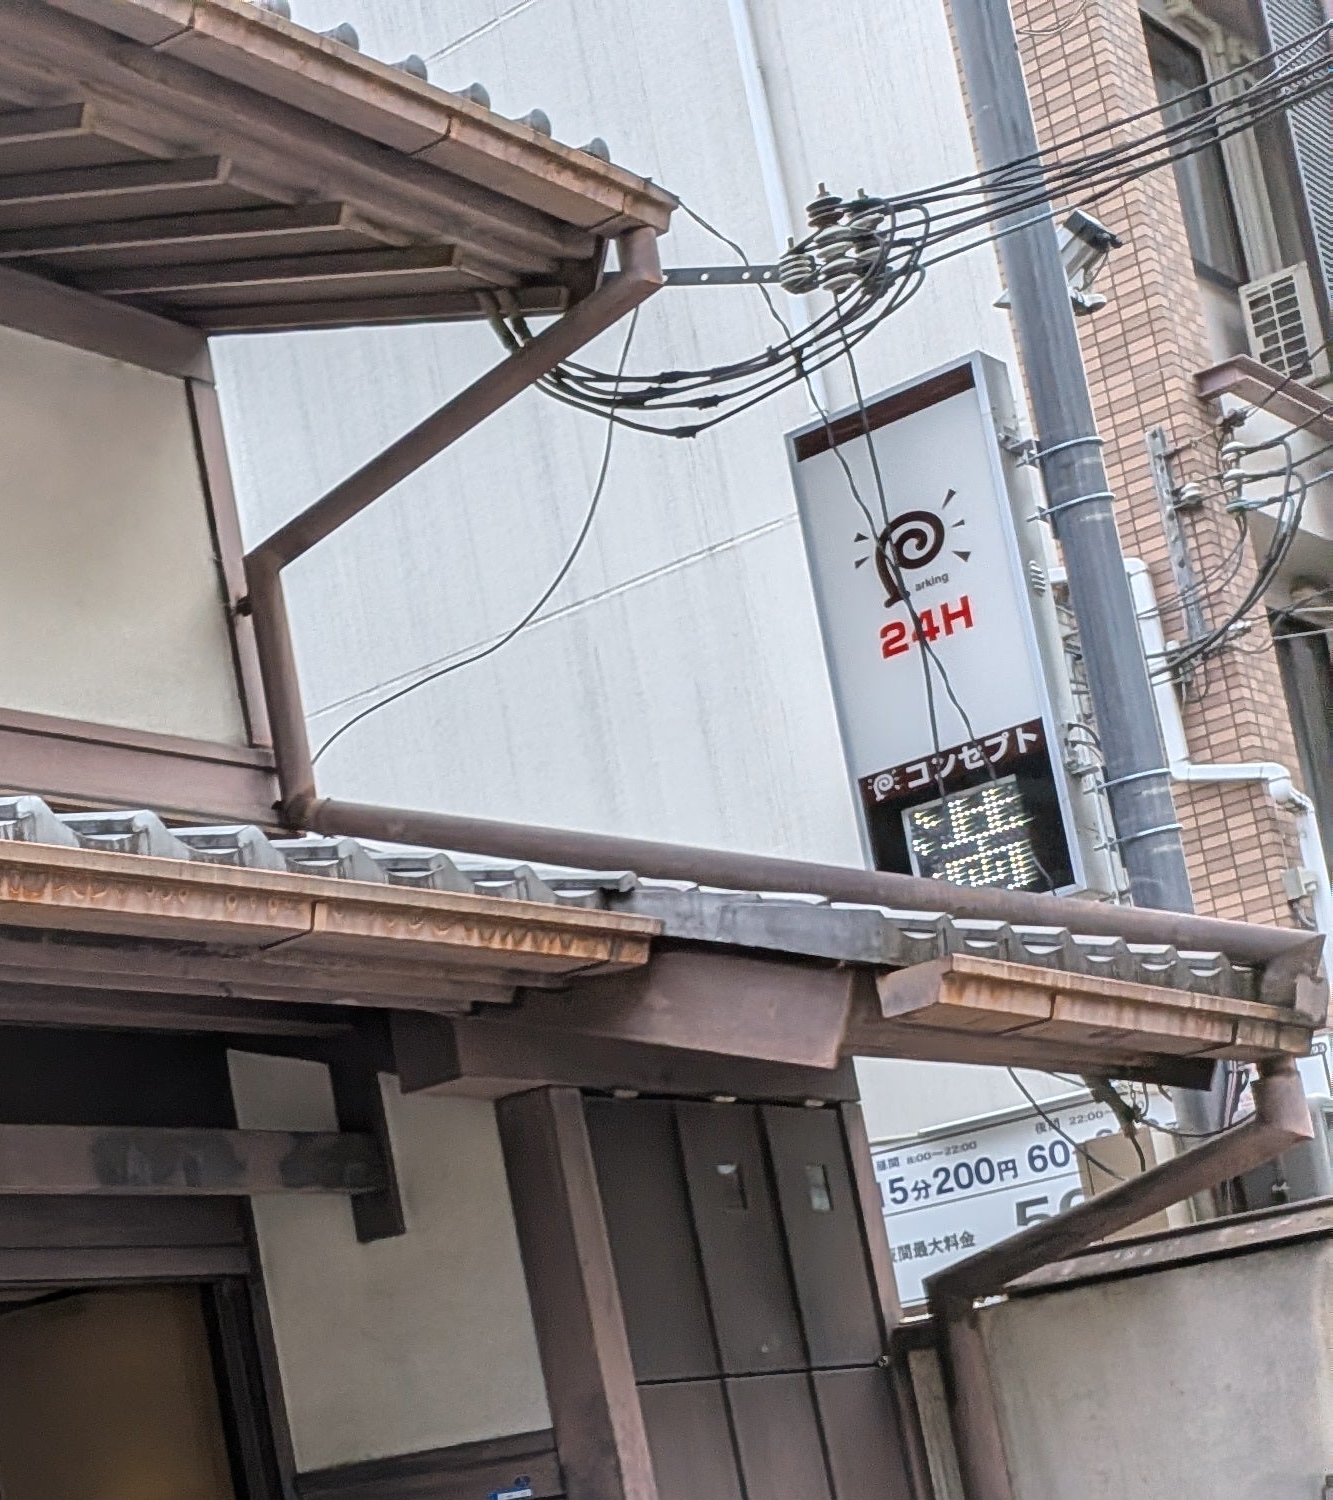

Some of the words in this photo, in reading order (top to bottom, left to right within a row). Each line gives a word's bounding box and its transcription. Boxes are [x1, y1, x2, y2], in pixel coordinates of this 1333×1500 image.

[879, 596, 974, 660] 24H
[906, 728, 1037, 789] コンセプト
